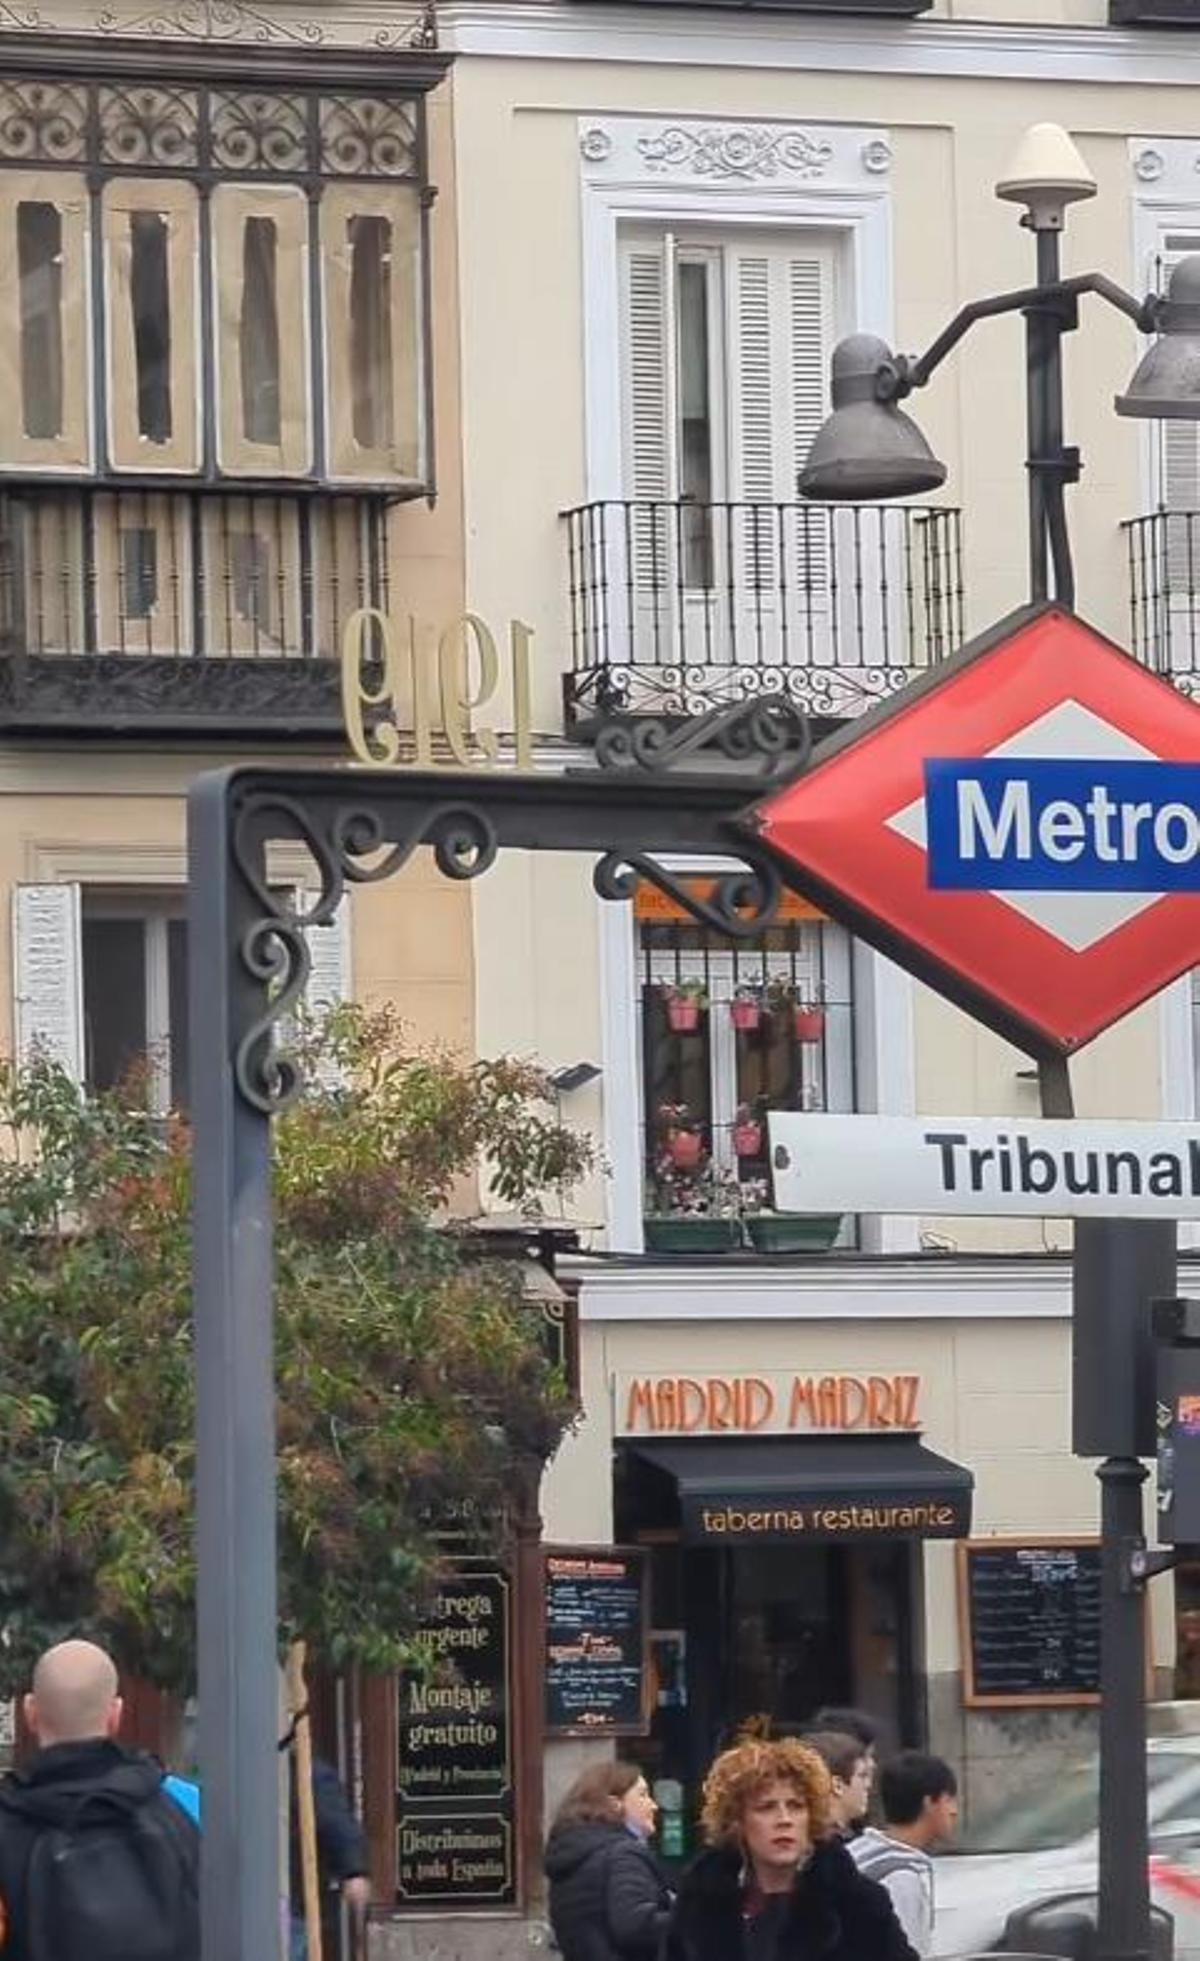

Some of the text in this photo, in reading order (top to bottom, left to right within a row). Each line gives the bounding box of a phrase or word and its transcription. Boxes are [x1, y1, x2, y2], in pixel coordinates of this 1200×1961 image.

[956, 779, 1200, 864] Metro
[924, 1134, 1200, 1198] Tribunal
[626, 1374, 924, 1432] MADRID MADRIZ
[702, 1502, 956, 1533] taberna restaurante
[410, 1680, 493, 1715] Montaje
[409, 1718, 498, 1752] gratuito
